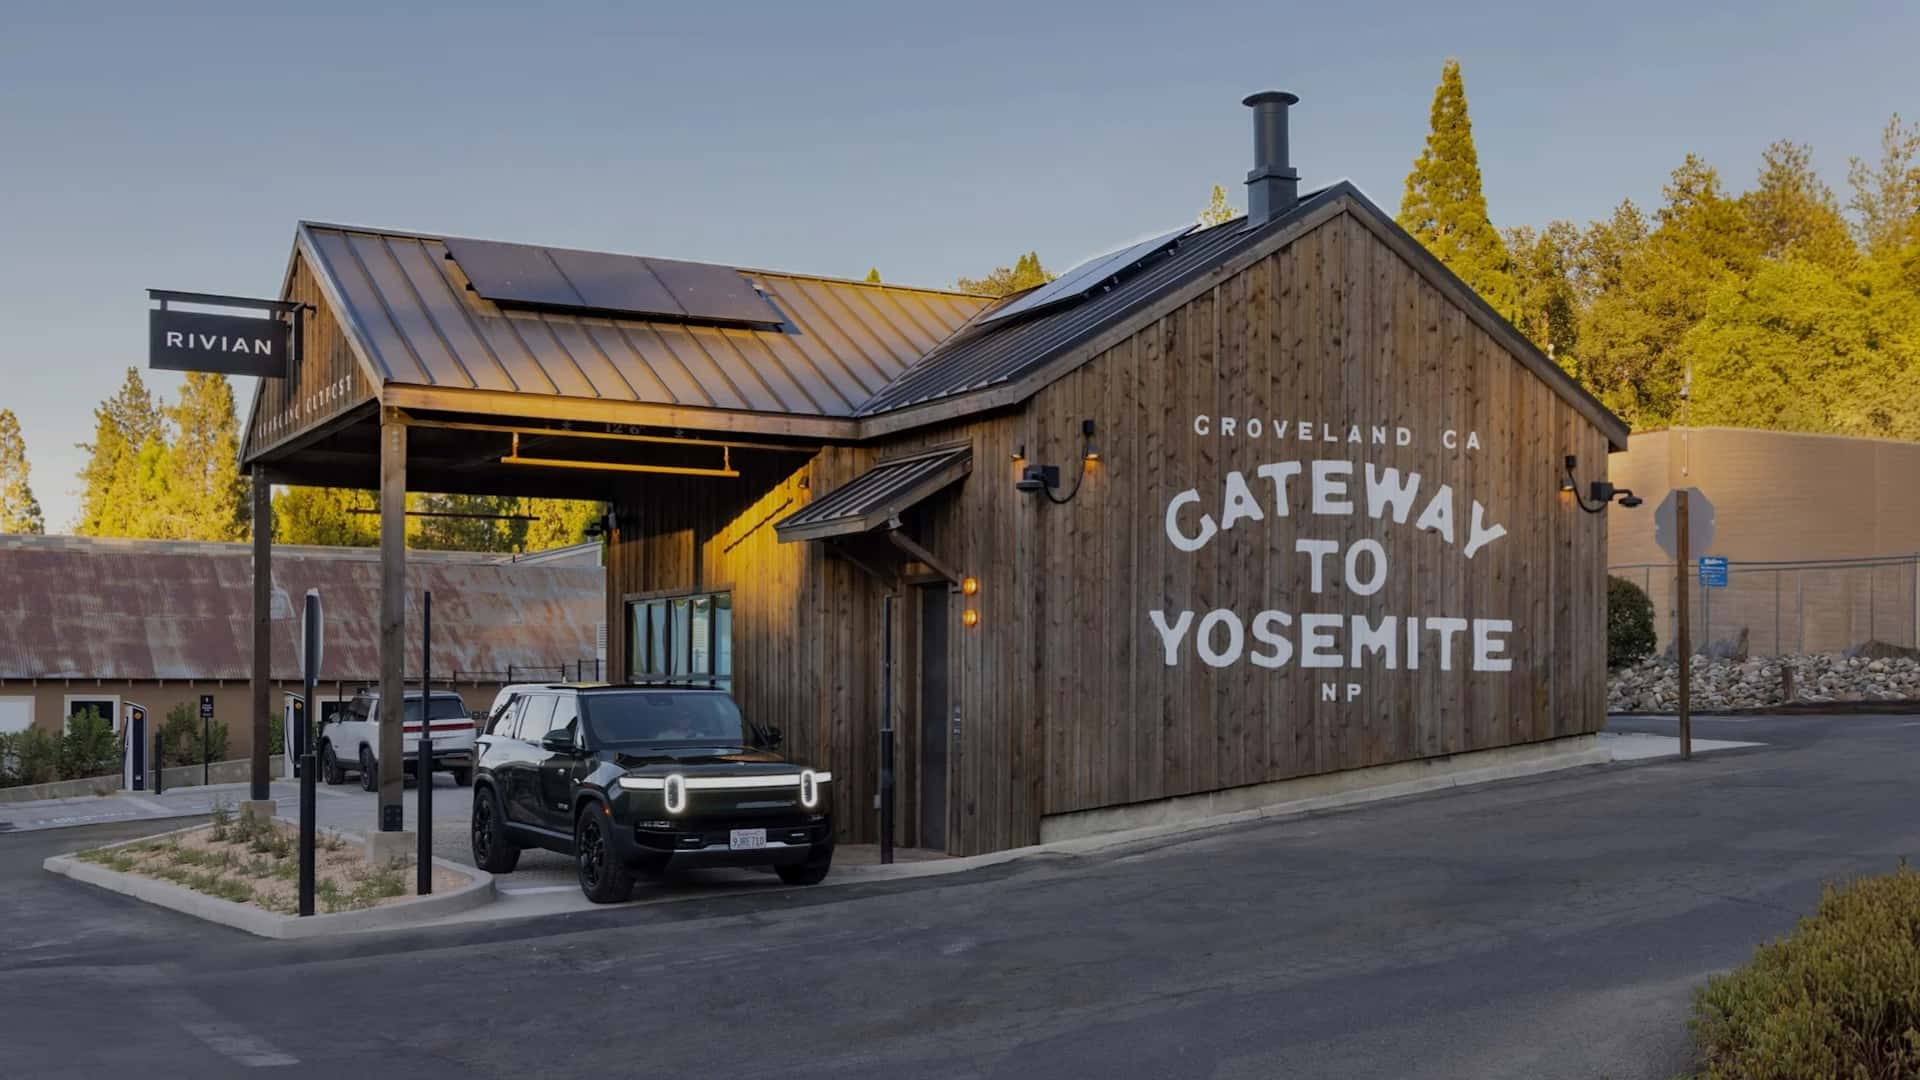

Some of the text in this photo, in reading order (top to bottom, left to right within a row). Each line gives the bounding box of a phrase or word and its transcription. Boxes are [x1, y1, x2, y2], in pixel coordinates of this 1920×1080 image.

[166, 331, 272, 355] RIVIAN
[1193, 414, 1481, 450] GROVELAND CA
[1165, 459, 1508, 560] GATEWAY
[1295, 538, 1388, 597] TO
[1149, 608, 1513, 672] YOSEMITE
